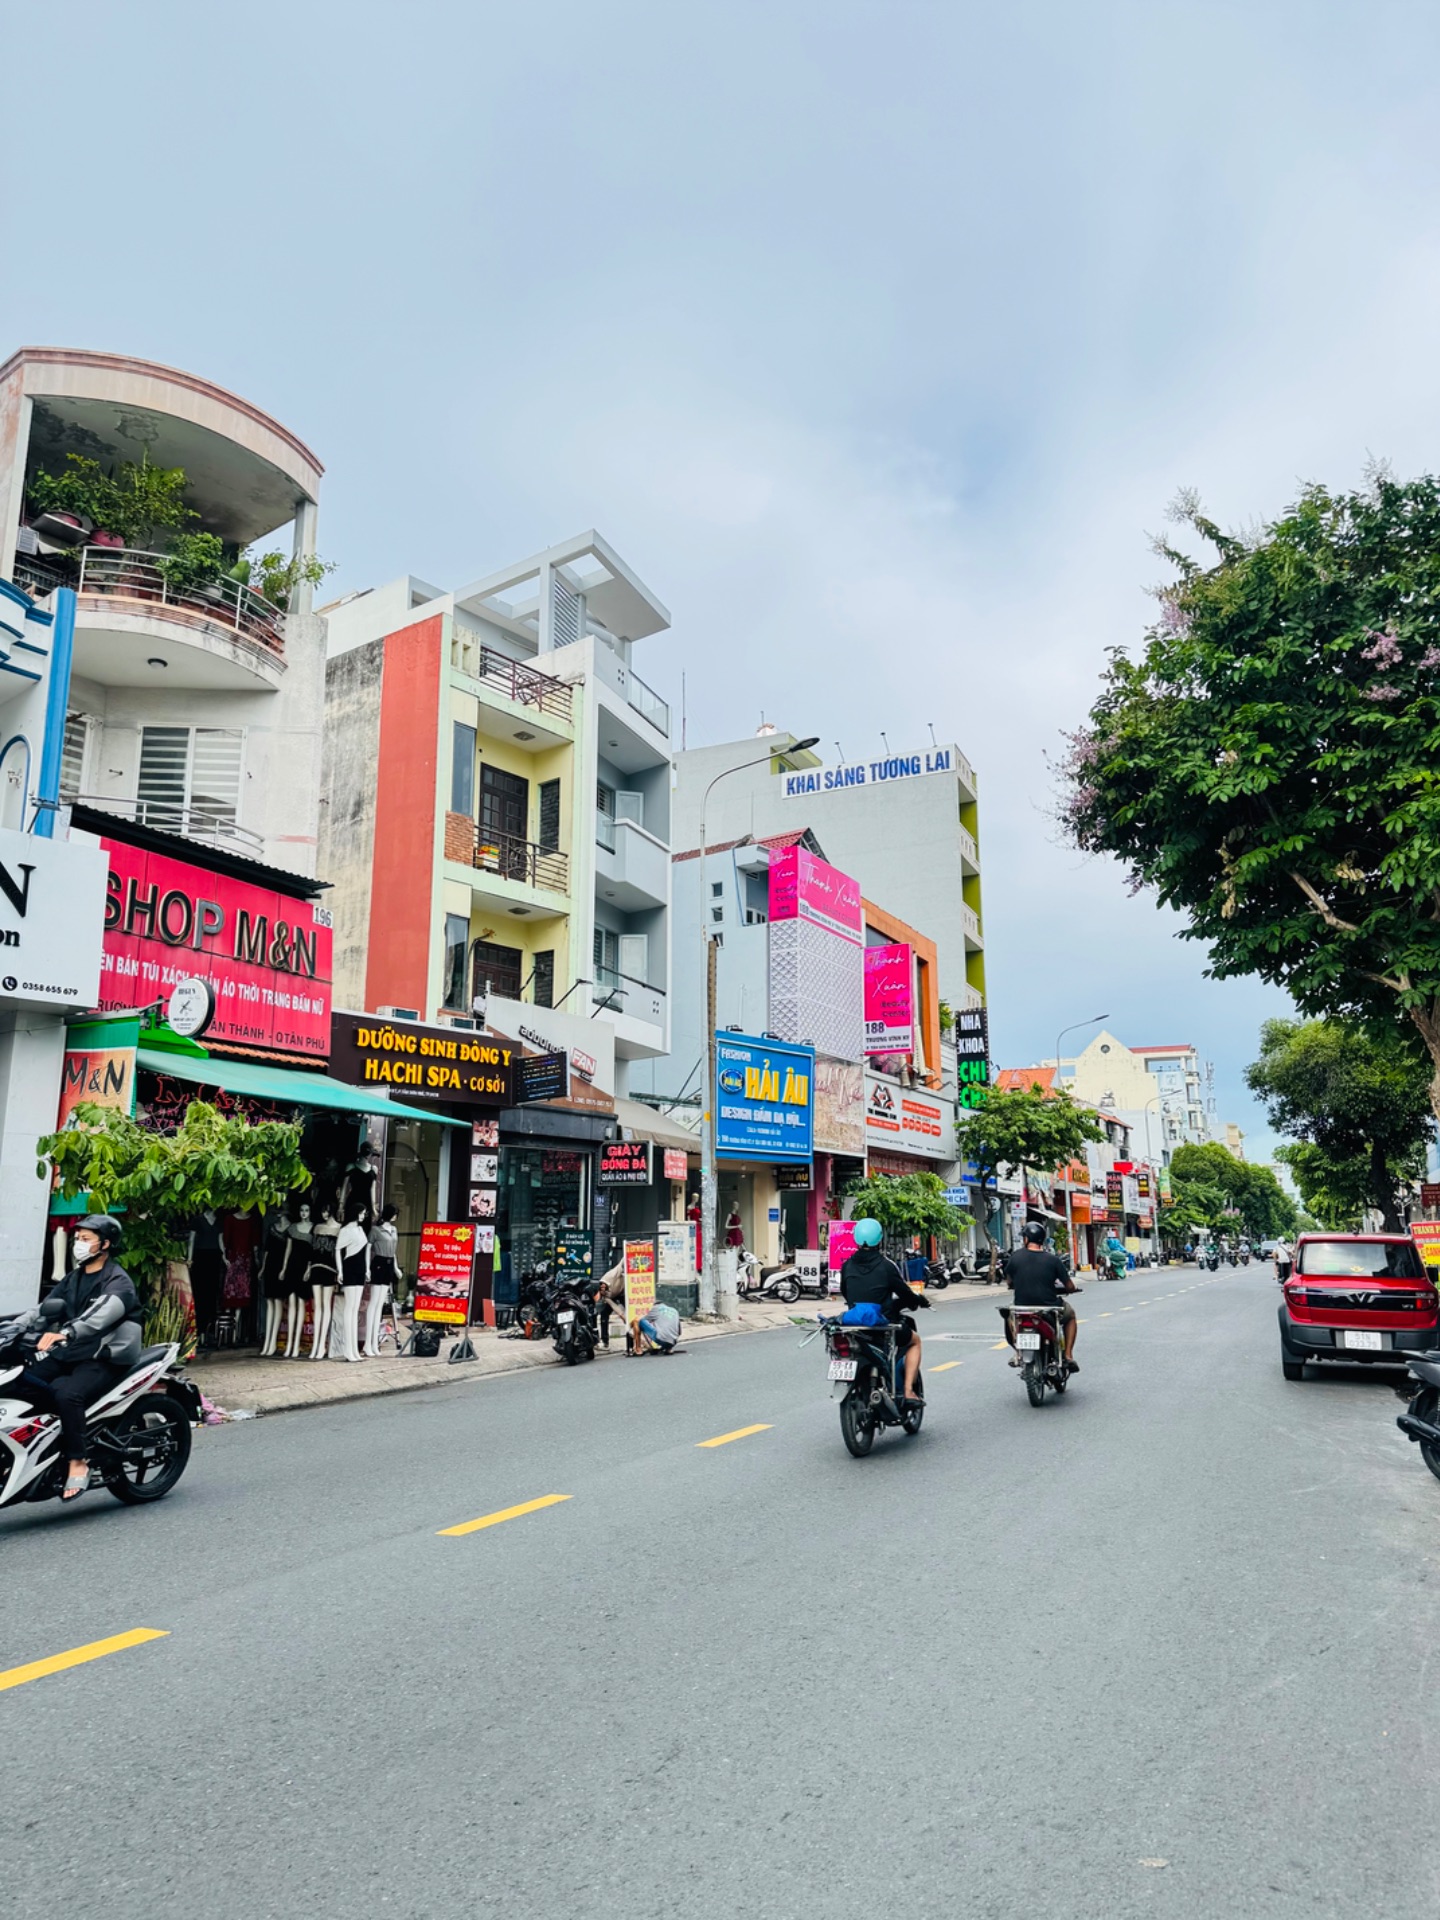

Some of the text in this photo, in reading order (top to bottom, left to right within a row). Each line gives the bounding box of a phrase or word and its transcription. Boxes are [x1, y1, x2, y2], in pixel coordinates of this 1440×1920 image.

[787, 750, 950, 796] KHAI SÁNG TƯƠNG LAI
[105, 870, 316, 978] SHOP M&N
[314, 908, 332, 927] 196
[22, 982, 44, 992] 0358
[116, 954, 139, 976] BÁN
[142, 960, 160, 982] TÚI
[222, 976, 235, 998] ÁO
[238, 981, 259, 1003] THỜI
[262, 988, 290, 1010] TRANG
[865, 1021, 885, 1035] 188
[960, 1014, 981, 1031] NHA
[357, 1025, 512, 1067] DƯỠNG SINH ĐÔNG Y
[958, 1037, 985, 1054] KHOA
[573, 1050, 596, 1075] FAN
[959, 1060, 987, 1082] CHI
[61, 1057, 127, 1098] M&N
[365, 1058, 423, 1085] HACHI
[427, 1066, 462, 1090] SPA
[744, 1058, 780, 1102] HẢI
[781, 1066, 809, 1106] ÂU
[607, 1143, 642, 1157] GIÀY
[601, 1156, 647, 1171] BÓNG ĐÁ
[421, 1243, 436, 1252] 50%
[419, 1261, 471, 1273] 20% Massage Body
